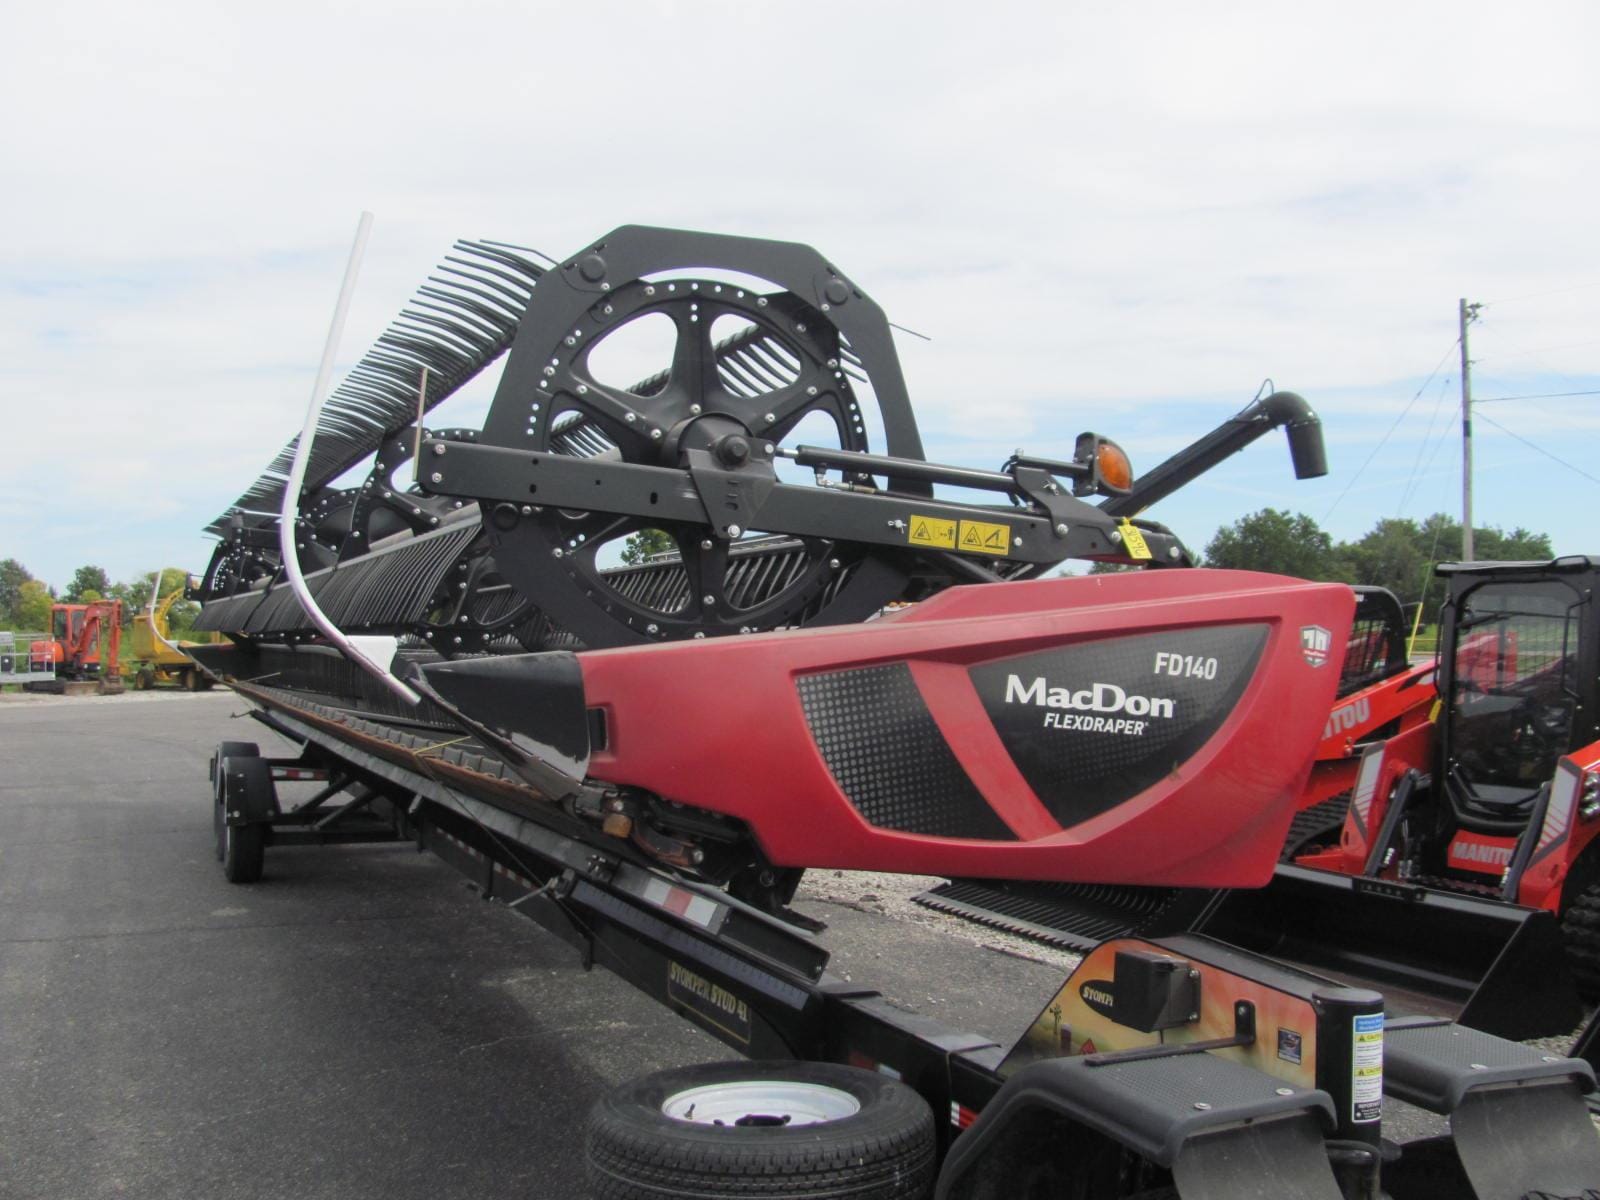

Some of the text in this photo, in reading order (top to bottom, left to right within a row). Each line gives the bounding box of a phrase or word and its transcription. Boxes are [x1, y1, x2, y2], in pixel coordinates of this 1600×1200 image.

[1154, 652, 1217, 680] FD140
[1005, 674, 1173, 719] MacDon
[1044, 713, 1144, 736] FLEXDRAPER
[711, 983, 737, 1015] STUD
